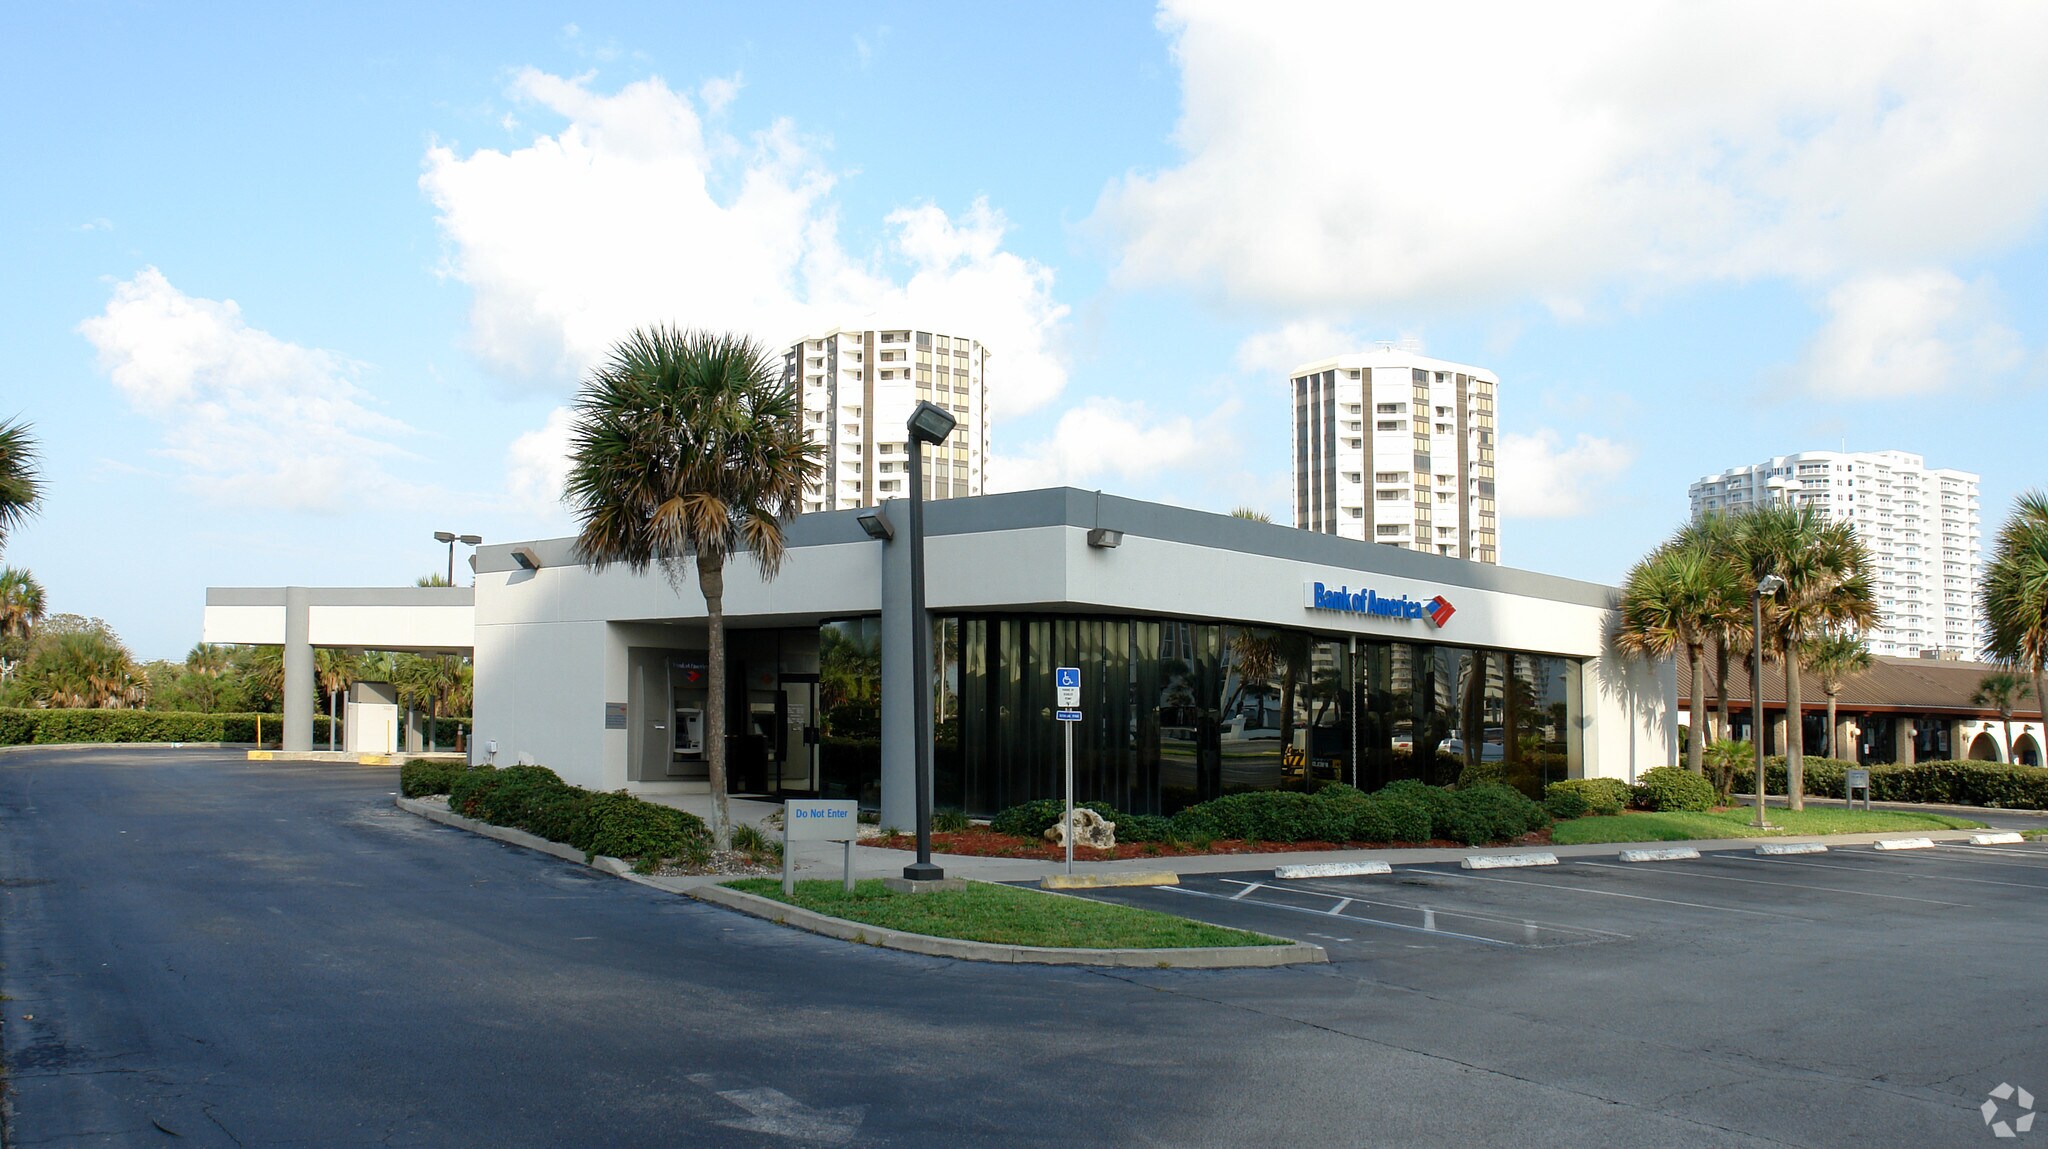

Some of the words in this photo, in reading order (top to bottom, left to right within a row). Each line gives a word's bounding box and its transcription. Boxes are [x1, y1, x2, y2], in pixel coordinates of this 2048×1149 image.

[1314, 582, 1352, 611] Bank
[1352, 588, 1368, 613] of
[1368, 589, 1423, 619] America
[795, 808, 808, 818] Do
[810, 808, 825, 818] Not
[827, 808, 848, 818] Enter
